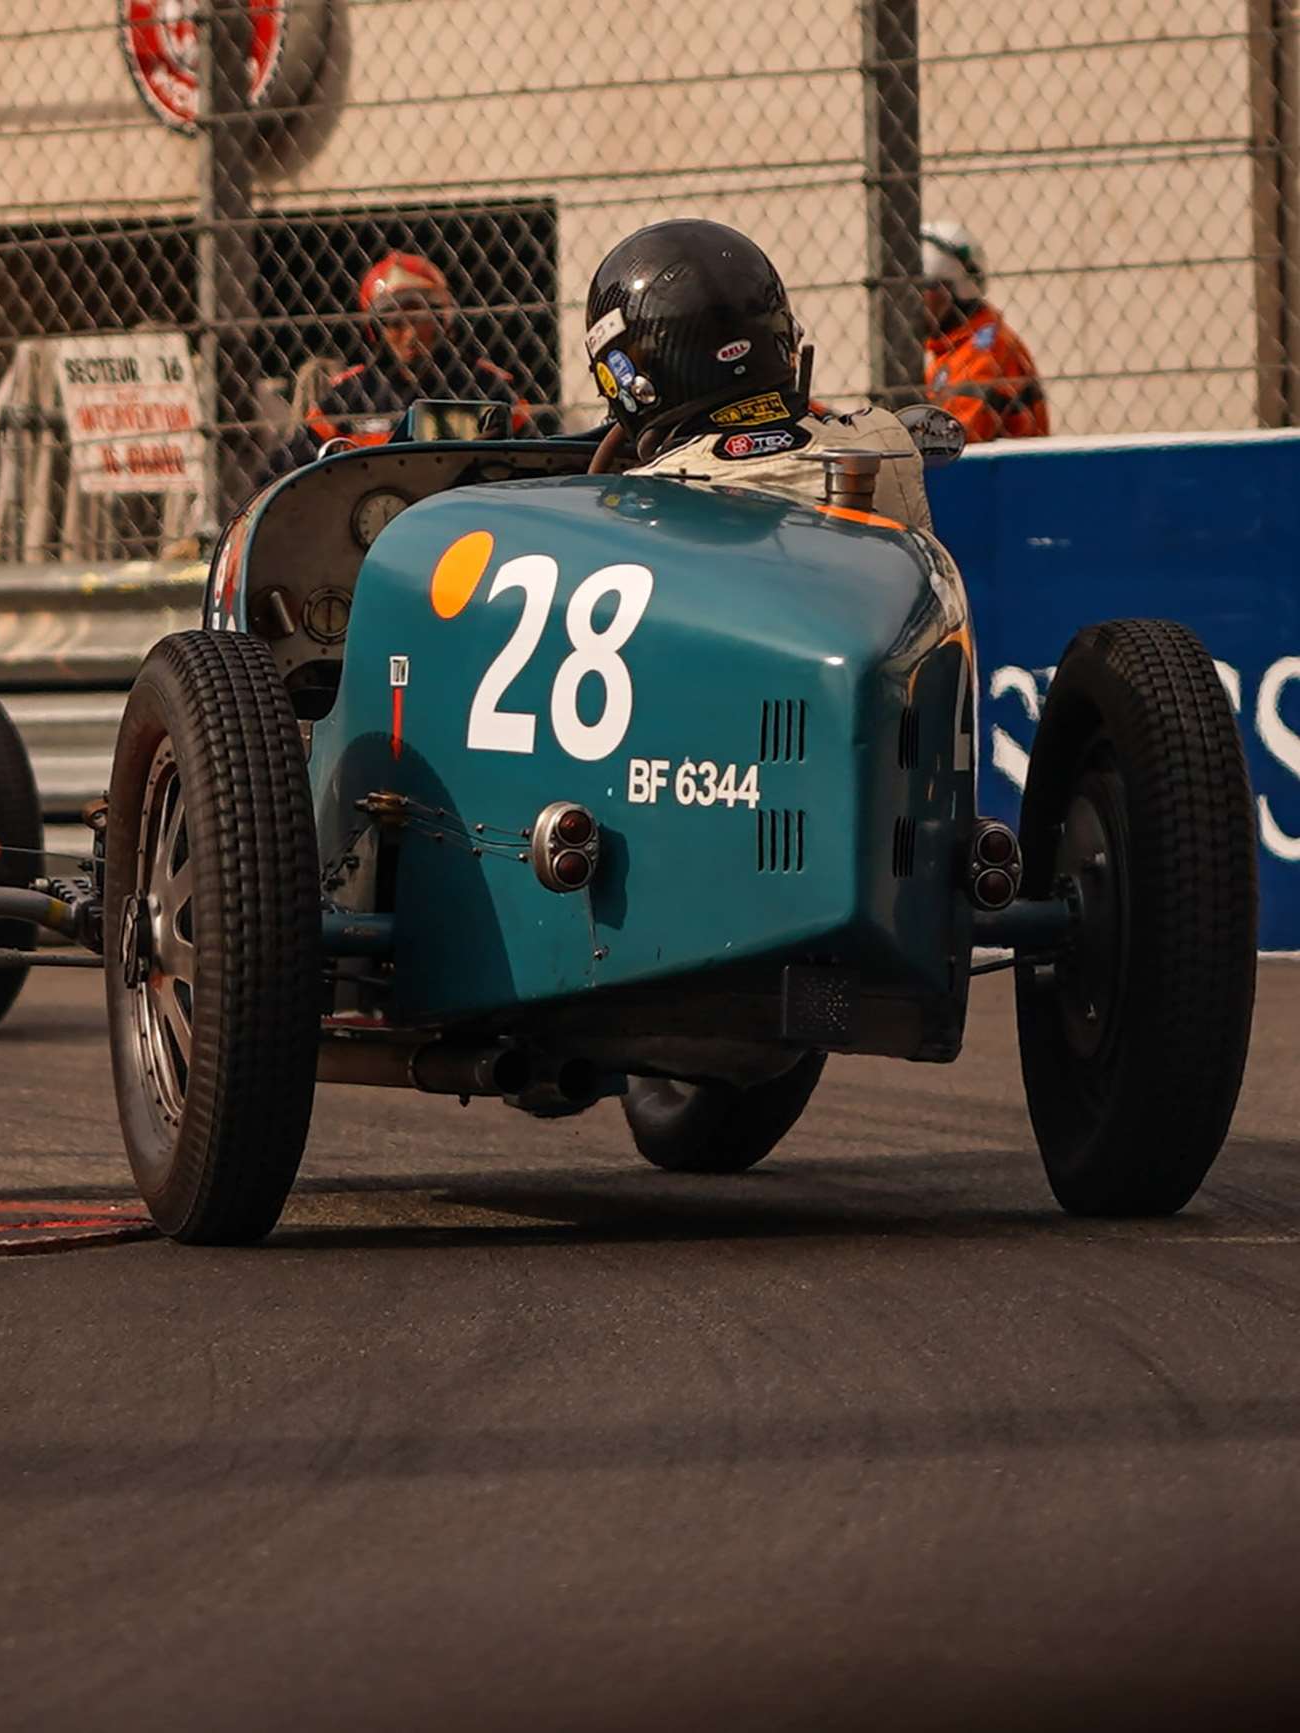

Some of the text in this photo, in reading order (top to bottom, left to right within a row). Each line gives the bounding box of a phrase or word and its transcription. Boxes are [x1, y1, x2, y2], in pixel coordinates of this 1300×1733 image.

[64, 355, 184, 384] SECTEUR 16
[721, 343, 748, 359] BELL
[467, 554, 654, 761] 28
[628, 758, 760, 808] BF 6344
